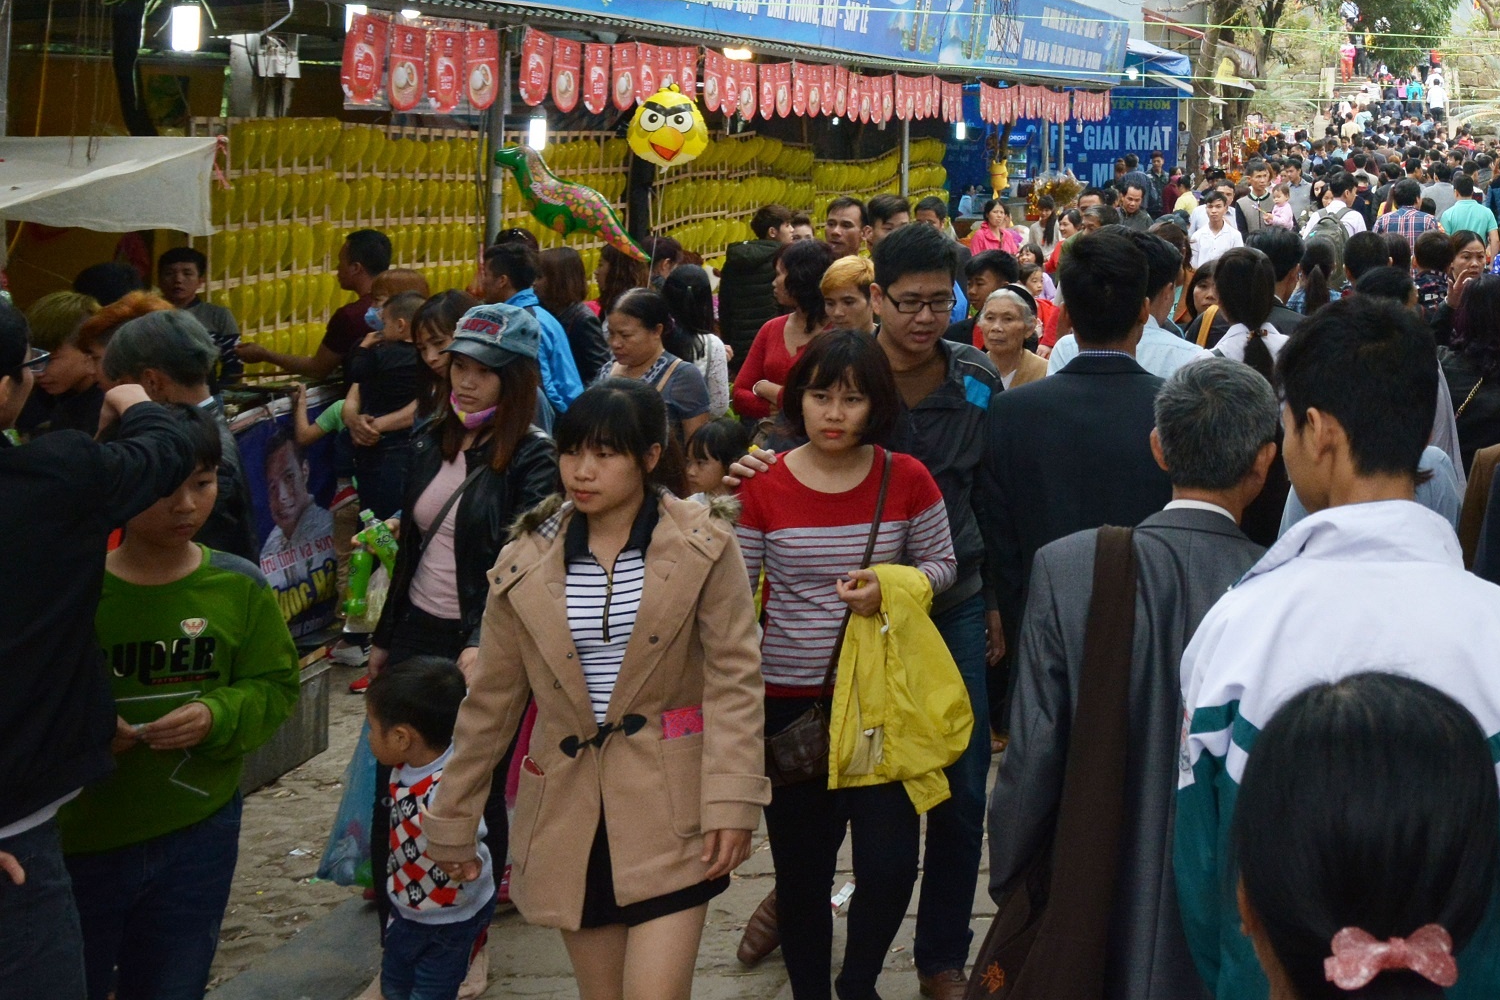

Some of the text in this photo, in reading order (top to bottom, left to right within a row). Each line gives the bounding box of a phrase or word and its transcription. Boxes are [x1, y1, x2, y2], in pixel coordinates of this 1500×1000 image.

[1083, 115, 1119, 151] GIẢI
[1125, 120, 1172, 151] KHÁT
[110, 637, 216, 686] UPER
